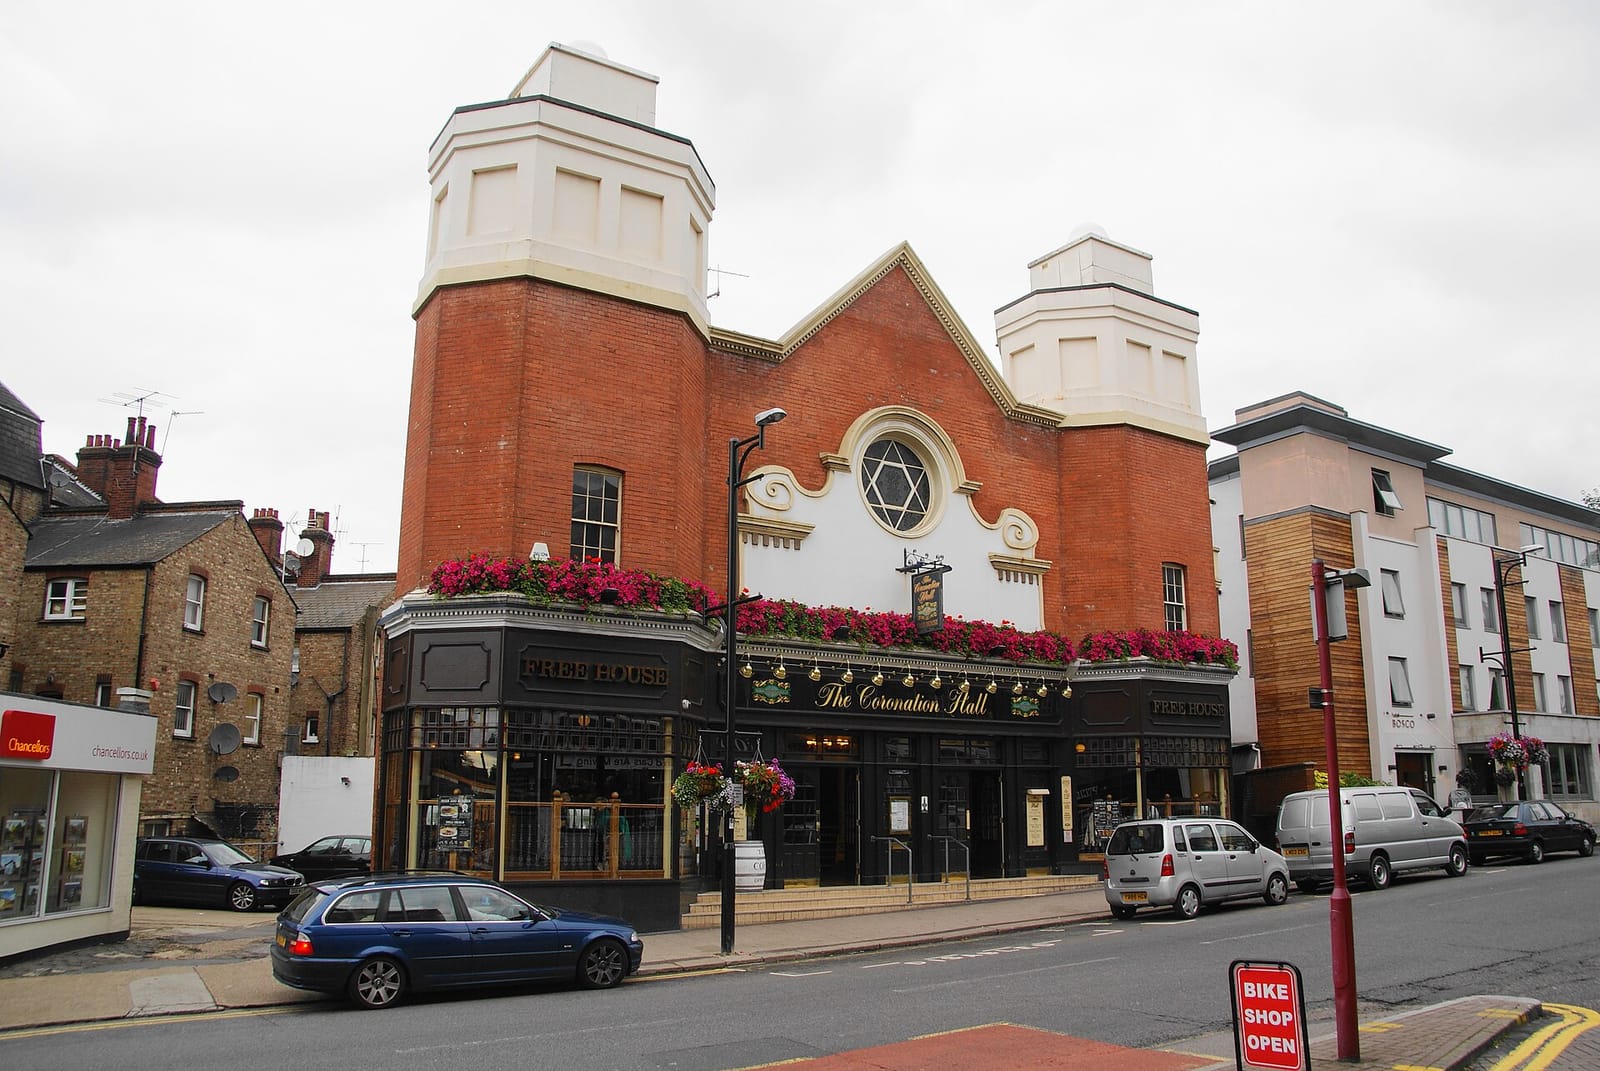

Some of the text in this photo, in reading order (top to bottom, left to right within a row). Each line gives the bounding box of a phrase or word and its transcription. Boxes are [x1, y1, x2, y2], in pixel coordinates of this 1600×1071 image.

[522, 656, 669, 686] FREE HOUSE
[814, 682, 988, 717] The Coronation Hall
[1152, 700, 1225, 717] FREE HOUSE
[1392, 719, 1415, 729] BOSCO
[8, 737, 51, 754] Chancellors
[91, 744, 149, 761] chancellors.co.uk
[1244, 982, 1289, 1000] BIKE
[1244, 1008, 1293, 1026] SHOP
[1247, 1034, 1296, 1054] OPEN
